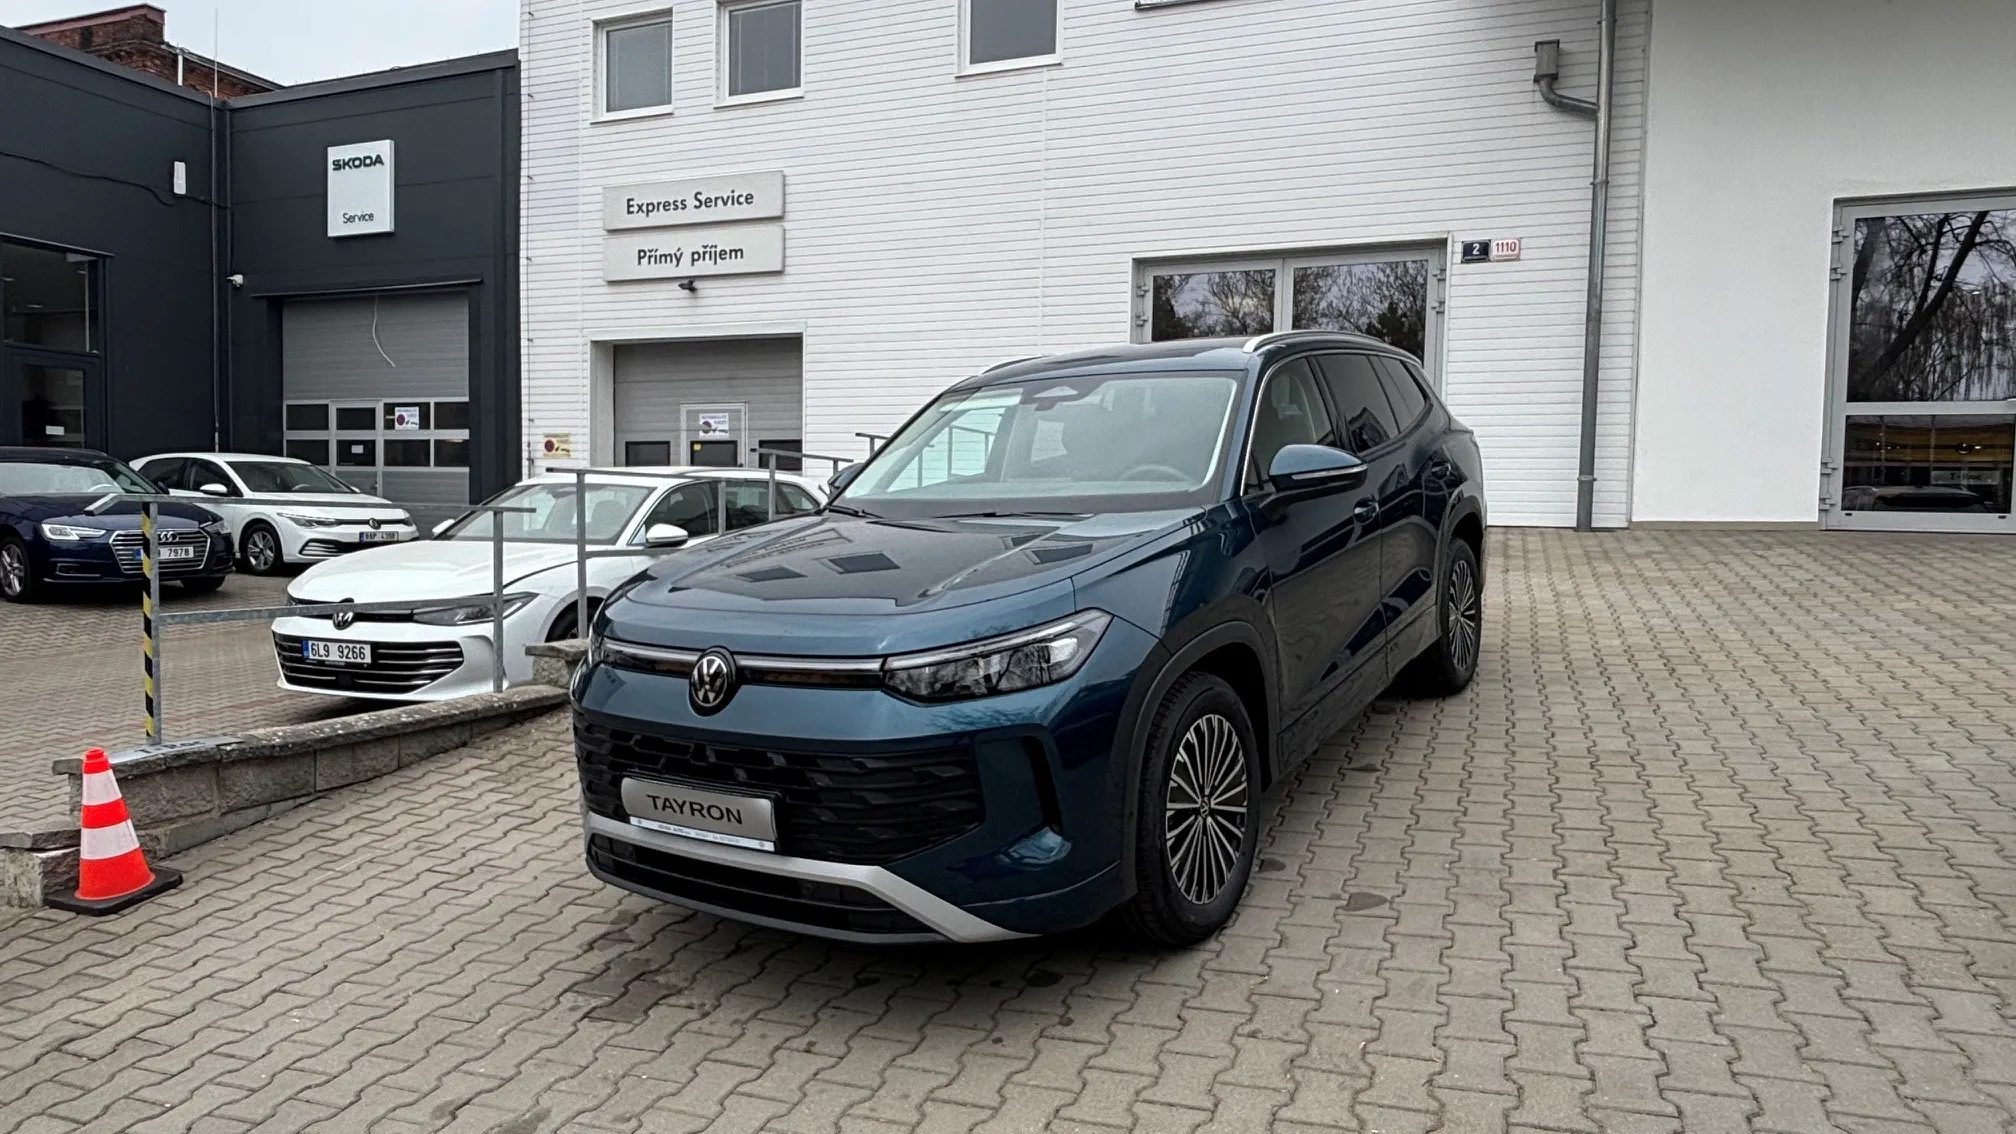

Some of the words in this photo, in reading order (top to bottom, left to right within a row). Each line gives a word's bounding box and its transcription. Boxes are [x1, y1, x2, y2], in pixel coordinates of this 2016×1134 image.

[626, 197, 687, 217] Express
[693, 190, 755, 210] Service
[342, 211, 374, 223] Service
[1472, 243, 1480, 255] 2
[1495, 241, 1517, 253] 1110
[637, 247, 683, 267] Přímý
[690, 244, 744, 267] příjem
[168, 548, 190, 557] 7978
[310, 642, 330, 658] 6L9
[337, 644, 366, 660] 9266
[647, 794, 743, 825] TAYRON
